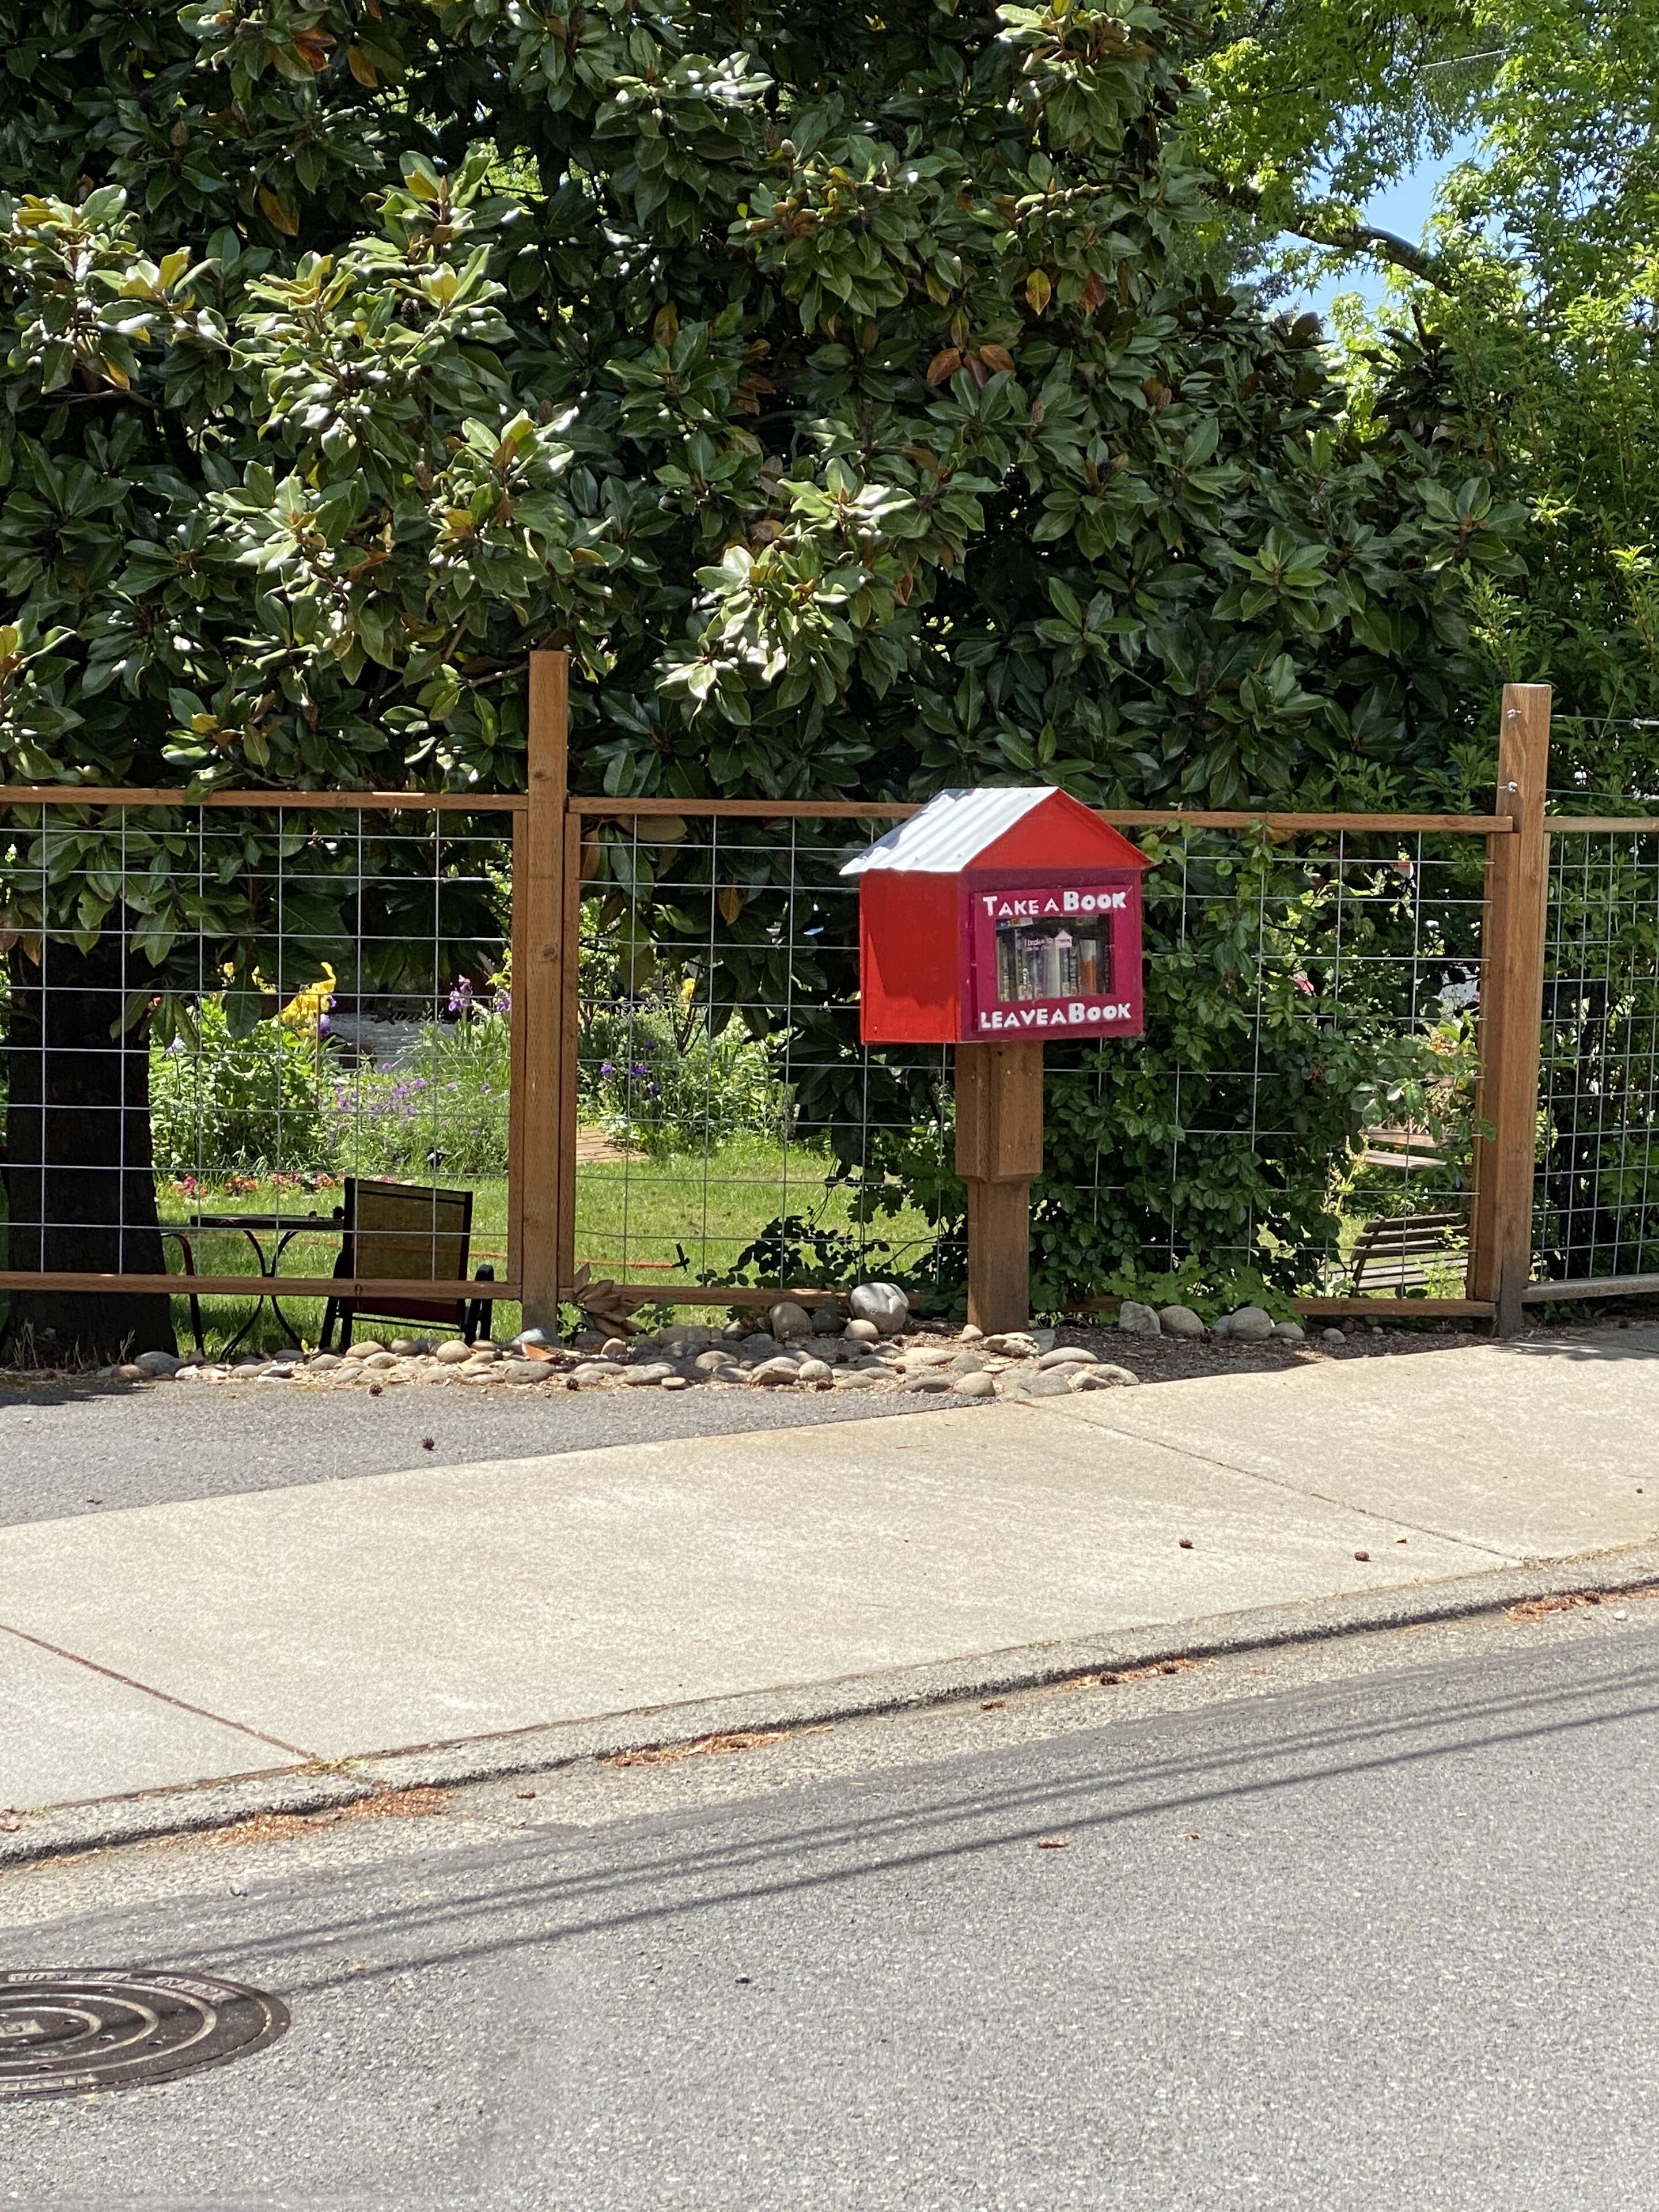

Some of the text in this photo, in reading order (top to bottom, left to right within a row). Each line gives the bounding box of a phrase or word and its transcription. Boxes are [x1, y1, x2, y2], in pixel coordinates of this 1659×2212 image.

[982, 891, 1127, 916] TAKE A BOOK
[980, 1008, 1048, 1028] LEAVE
[1069, 1002, 1132, 1023] BOOK
